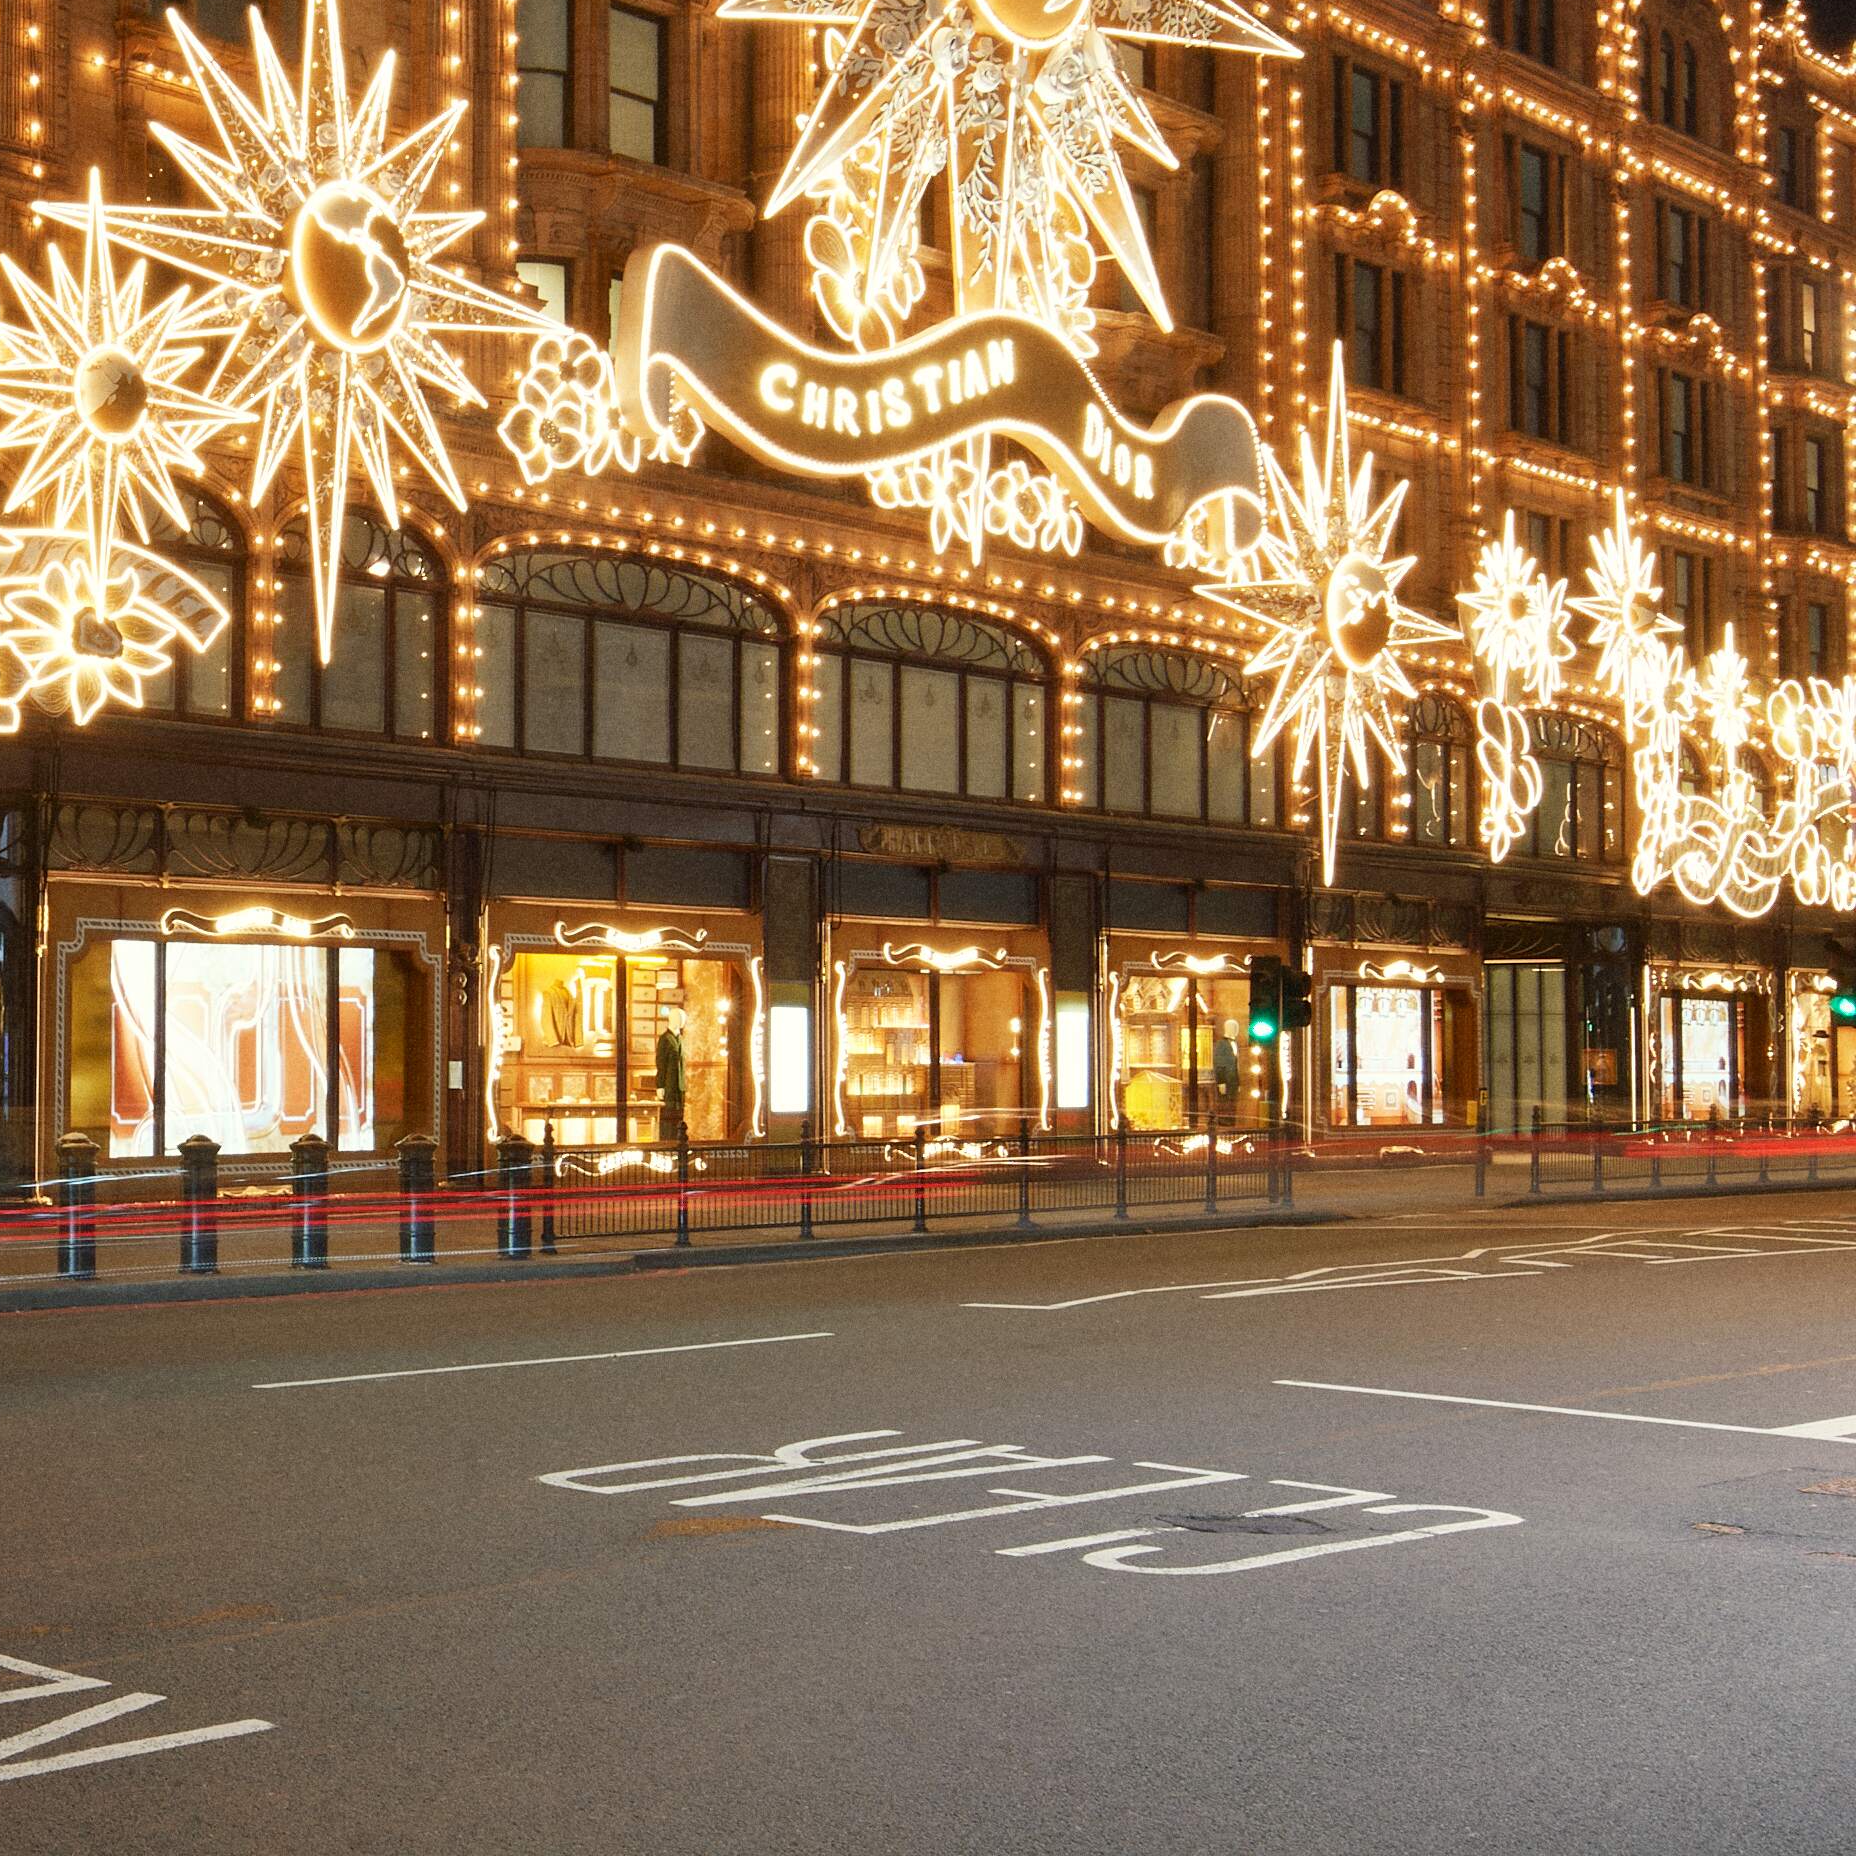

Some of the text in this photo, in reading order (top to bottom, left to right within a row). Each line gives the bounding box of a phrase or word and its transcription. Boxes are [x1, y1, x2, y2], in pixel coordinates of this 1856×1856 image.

[759, 338, 1155, 500] CHRISTIAN DIOR
[537, 1429, 1525, 1575] CLEAR
